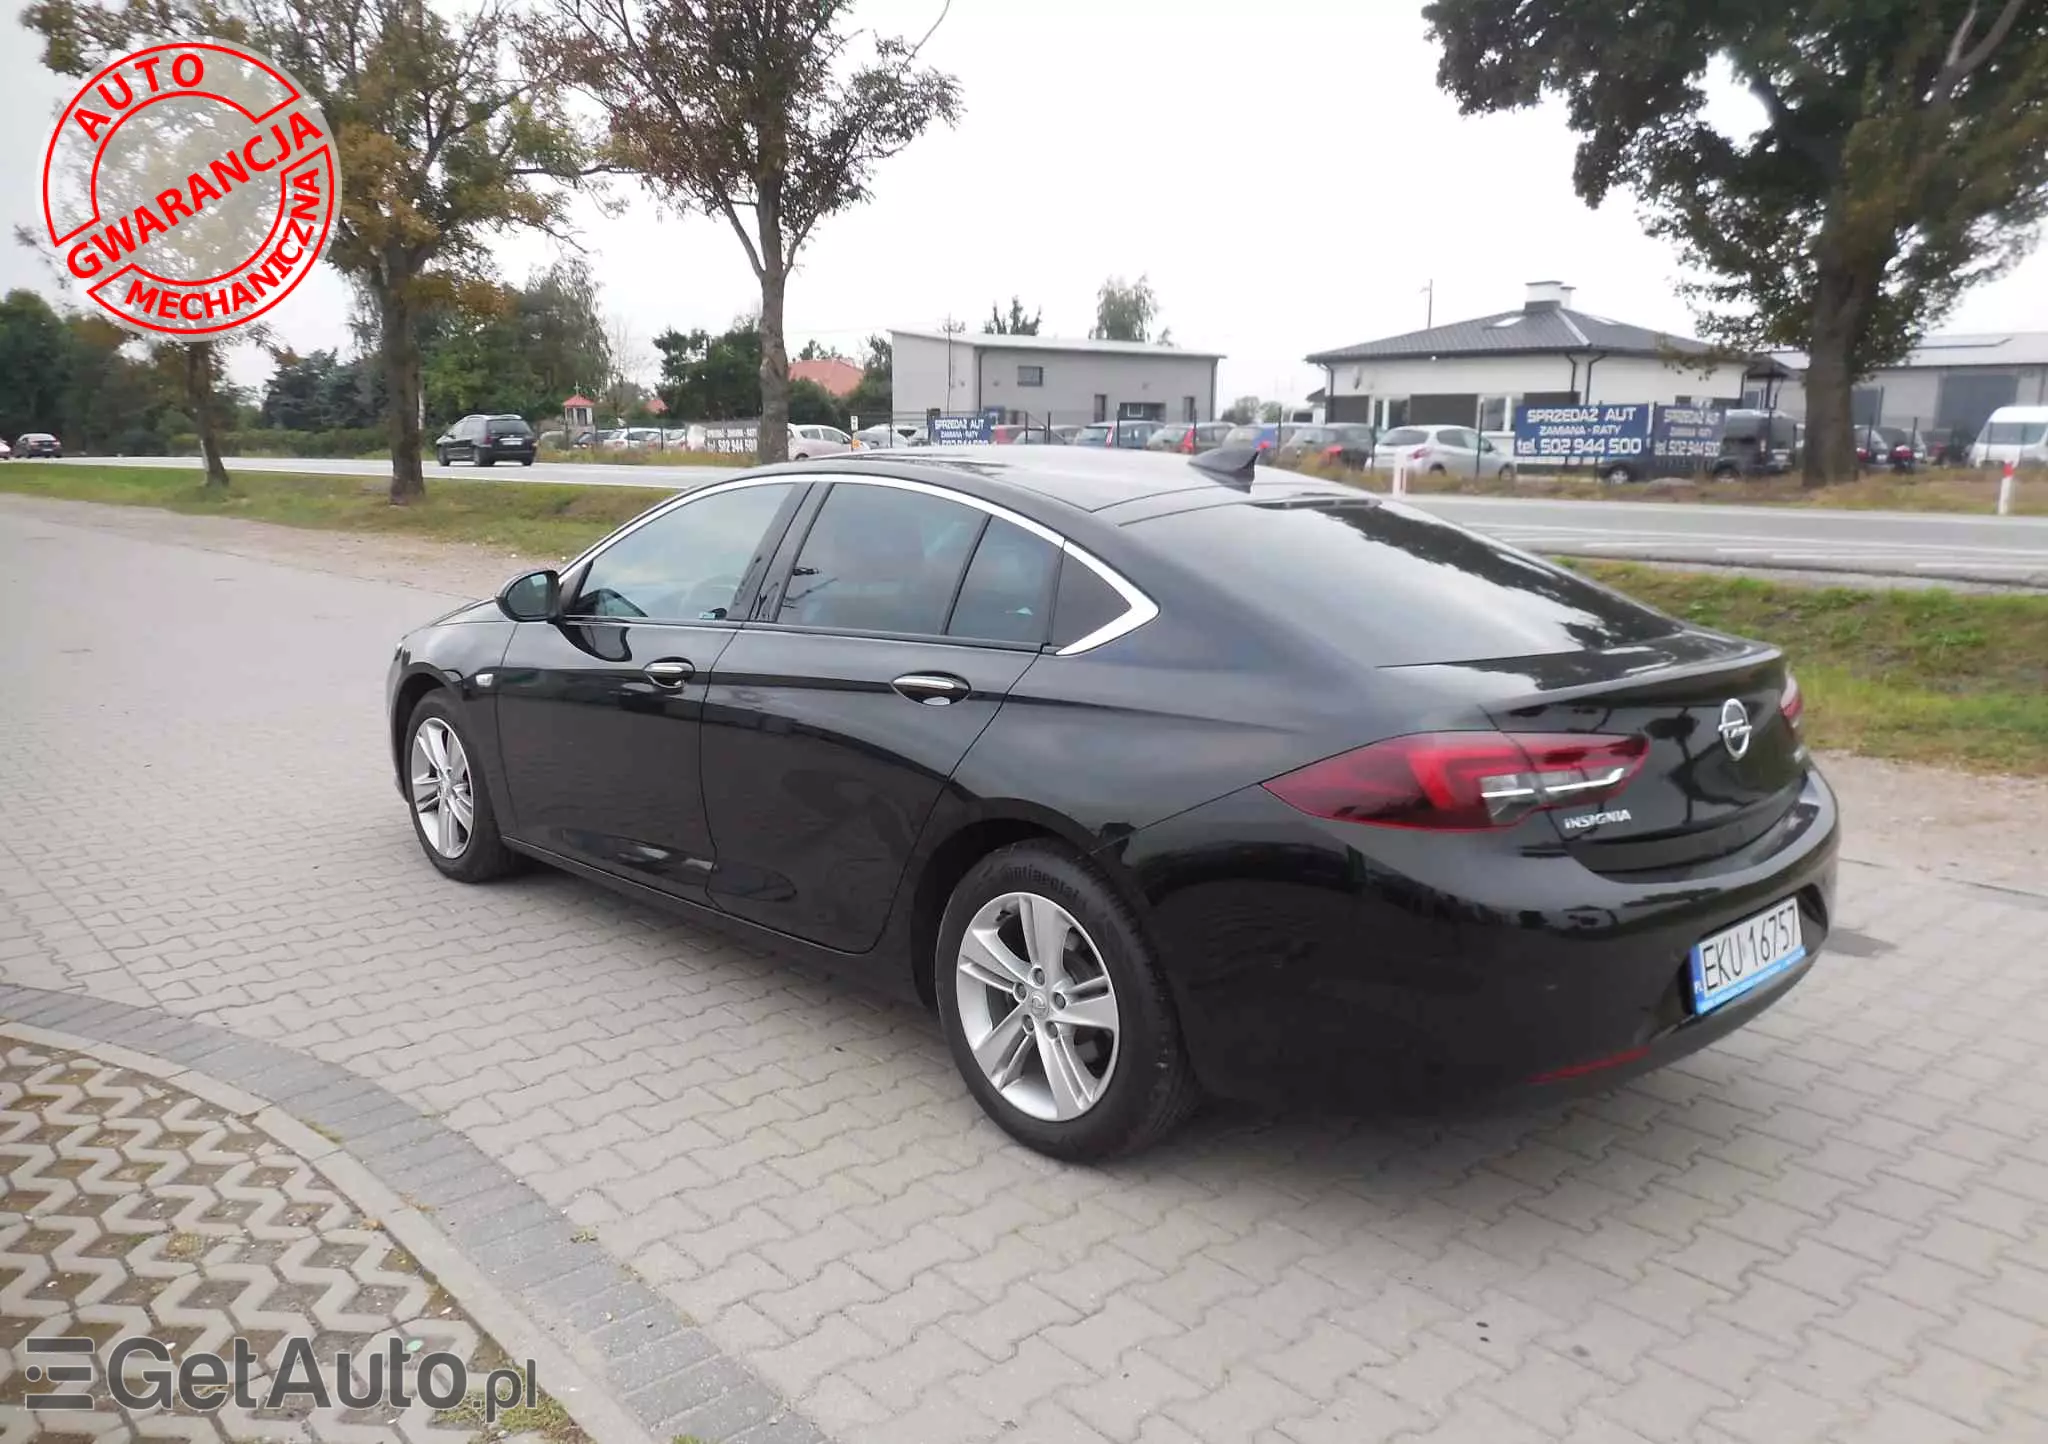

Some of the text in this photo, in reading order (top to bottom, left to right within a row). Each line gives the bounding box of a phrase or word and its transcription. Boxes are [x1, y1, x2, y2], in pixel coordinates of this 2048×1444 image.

[1604, 407, 1637, 421] AUT
[1539, 425, 1586, 436] ZAMIANA
[1592, 425, 1621, 435] RATY
[1540, 438, 1571, 454] 502
[1573, 438, 1605, 454] 944
[1608, 437, 1641, 454] 500
[1564, 809, 1632, 829] INSIGNIA
[1703, 905, 1796, 991] EKU 16757
